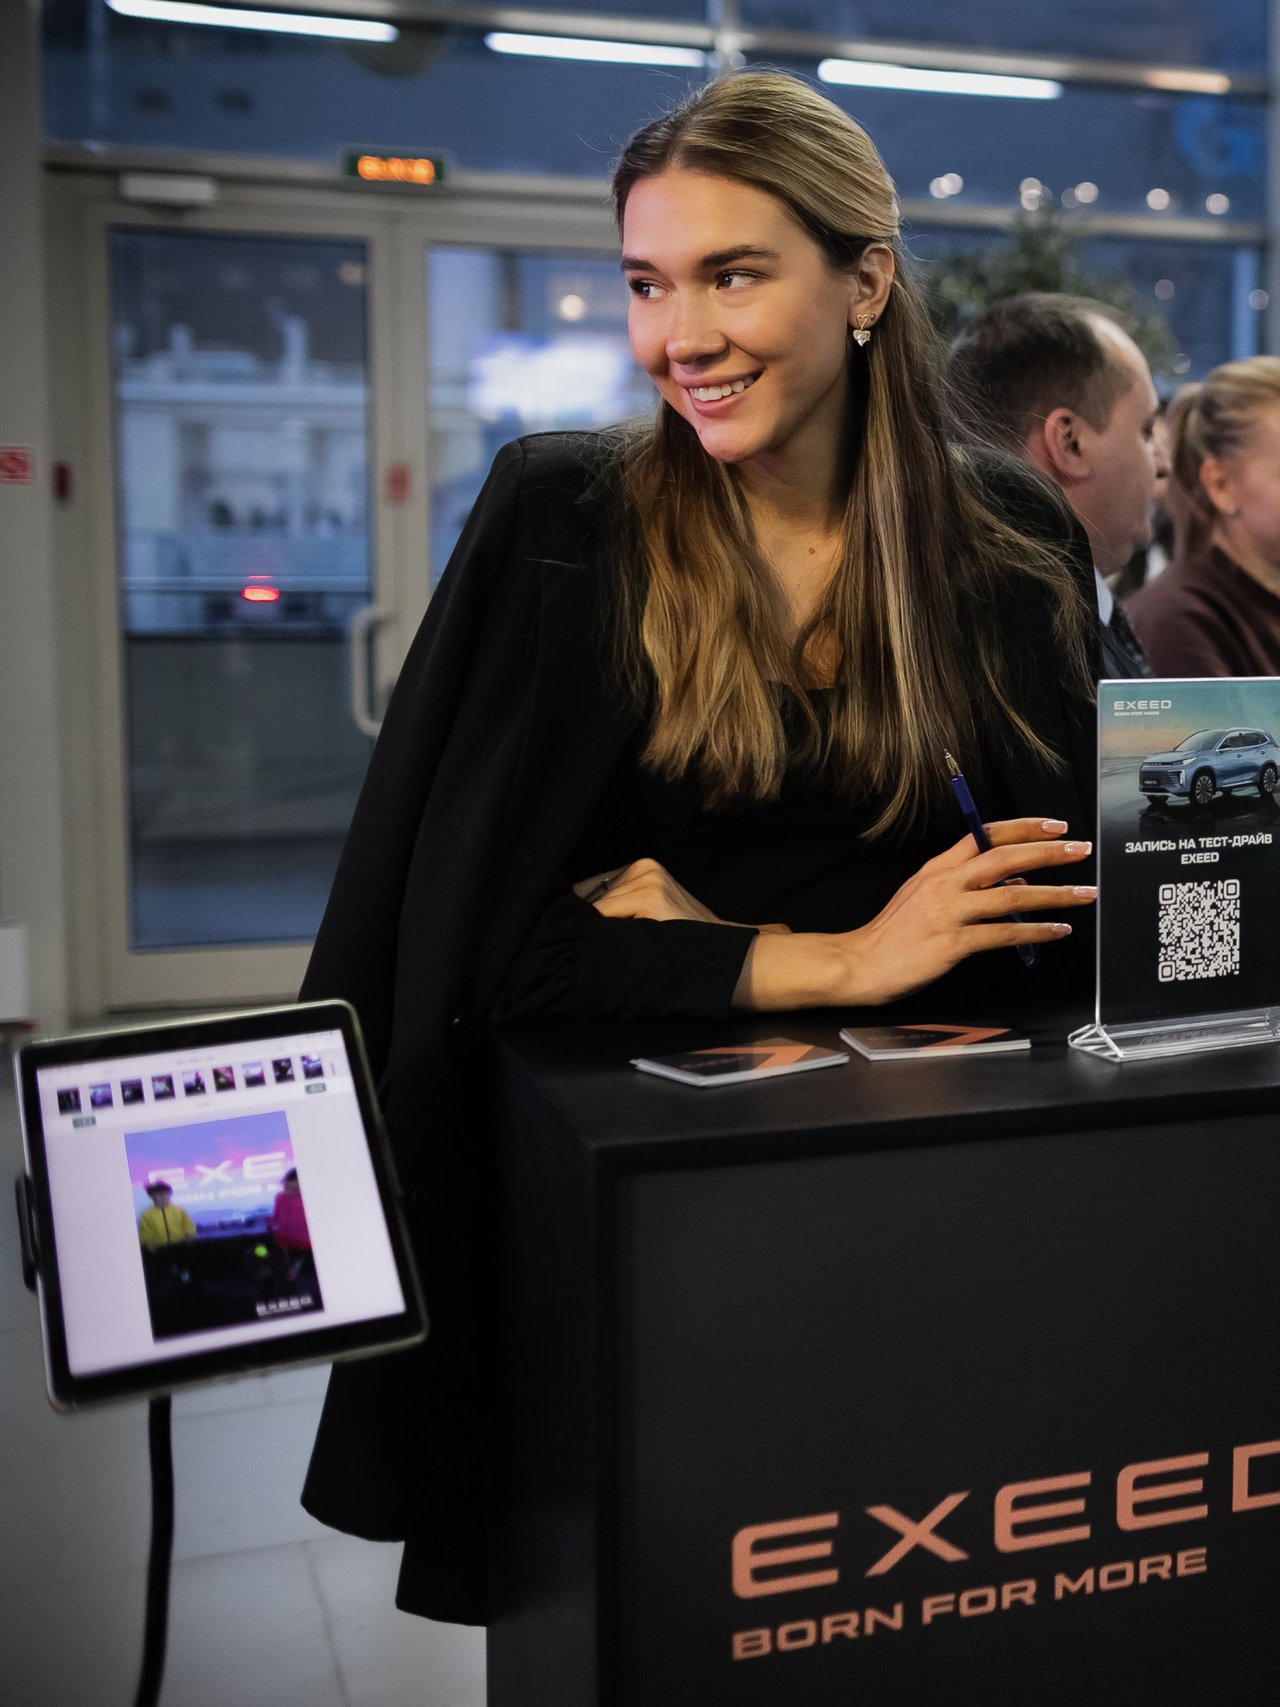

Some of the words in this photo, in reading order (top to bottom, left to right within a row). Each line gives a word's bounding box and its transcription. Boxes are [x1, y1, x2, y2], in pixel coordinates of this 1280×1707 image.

[1113, 700, 1172, 710] EXEED
[1124, 839, 1177, 854] ЗАПИСЬ
[1178, 838, 1197, 850] НА
[1198, 832, 1274, 849] ТЕСТ-ДРАЙВ
[1180, 851, 1220, 865] EXEED
[732, 1602, 904, 1660] BORN
[921, 1579, 1038, 1625] FOR
[1053, 1546, 1207, 1601] MORE
